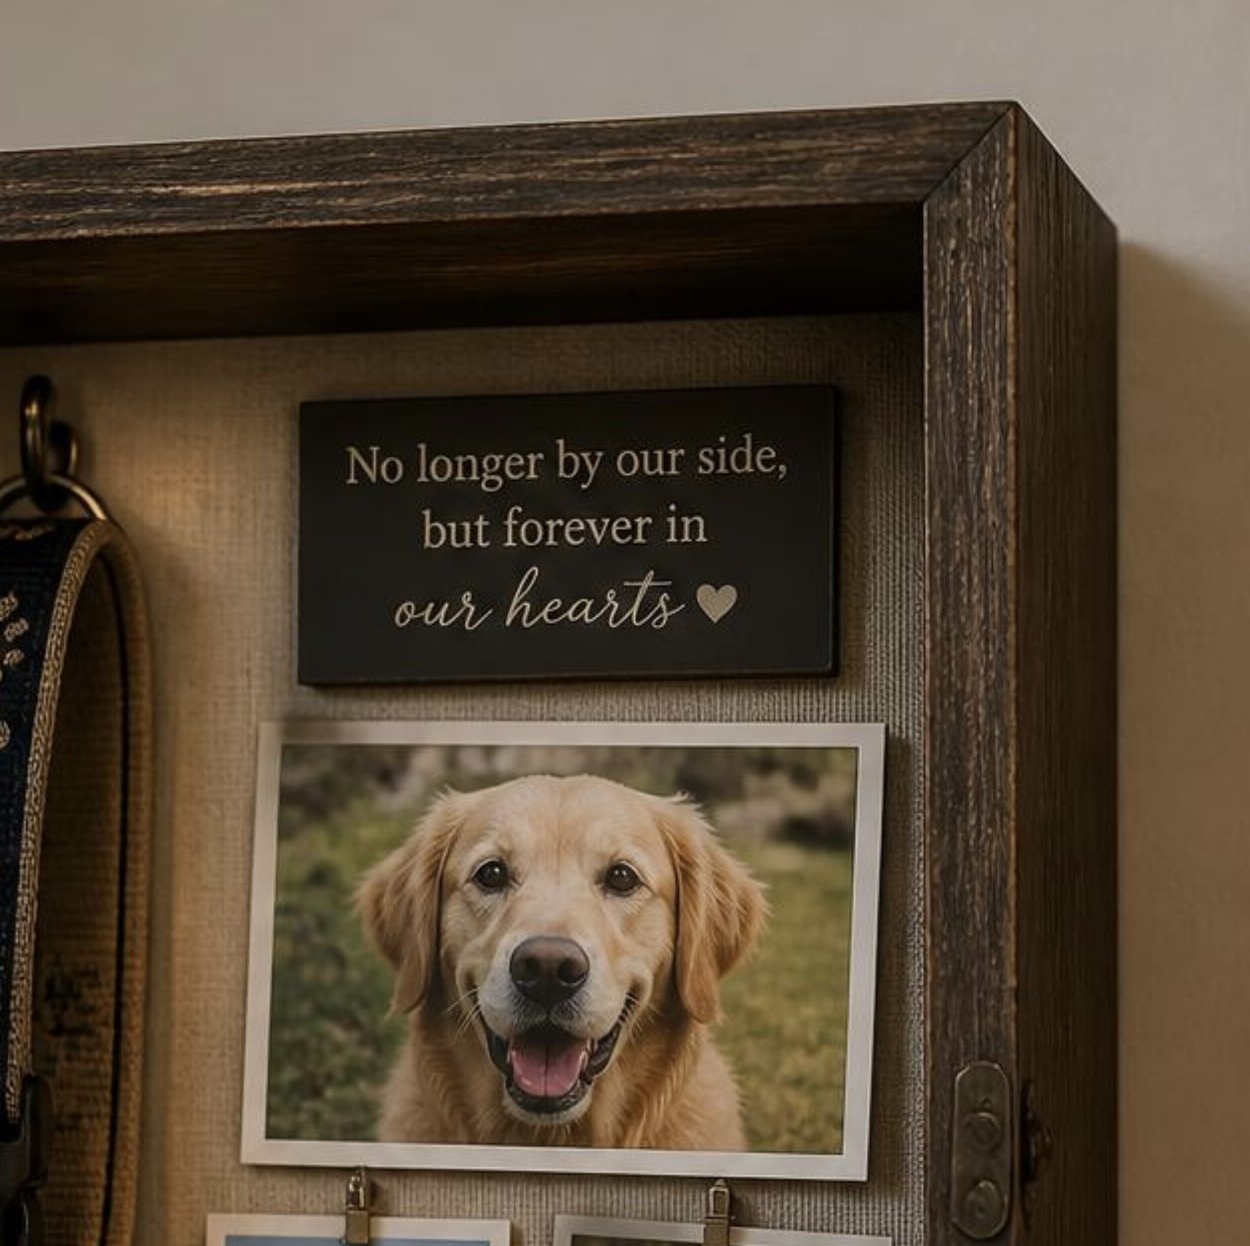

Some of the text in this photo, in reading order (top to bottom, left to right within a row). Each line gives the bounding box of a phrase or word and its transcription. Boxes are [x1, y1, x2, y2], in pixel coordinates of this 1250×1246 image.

[345, 434, 788, 493] No longer by our side,
[422, 504, 708, 549] but forever in
[394, 566, 687, 631] our hearts
